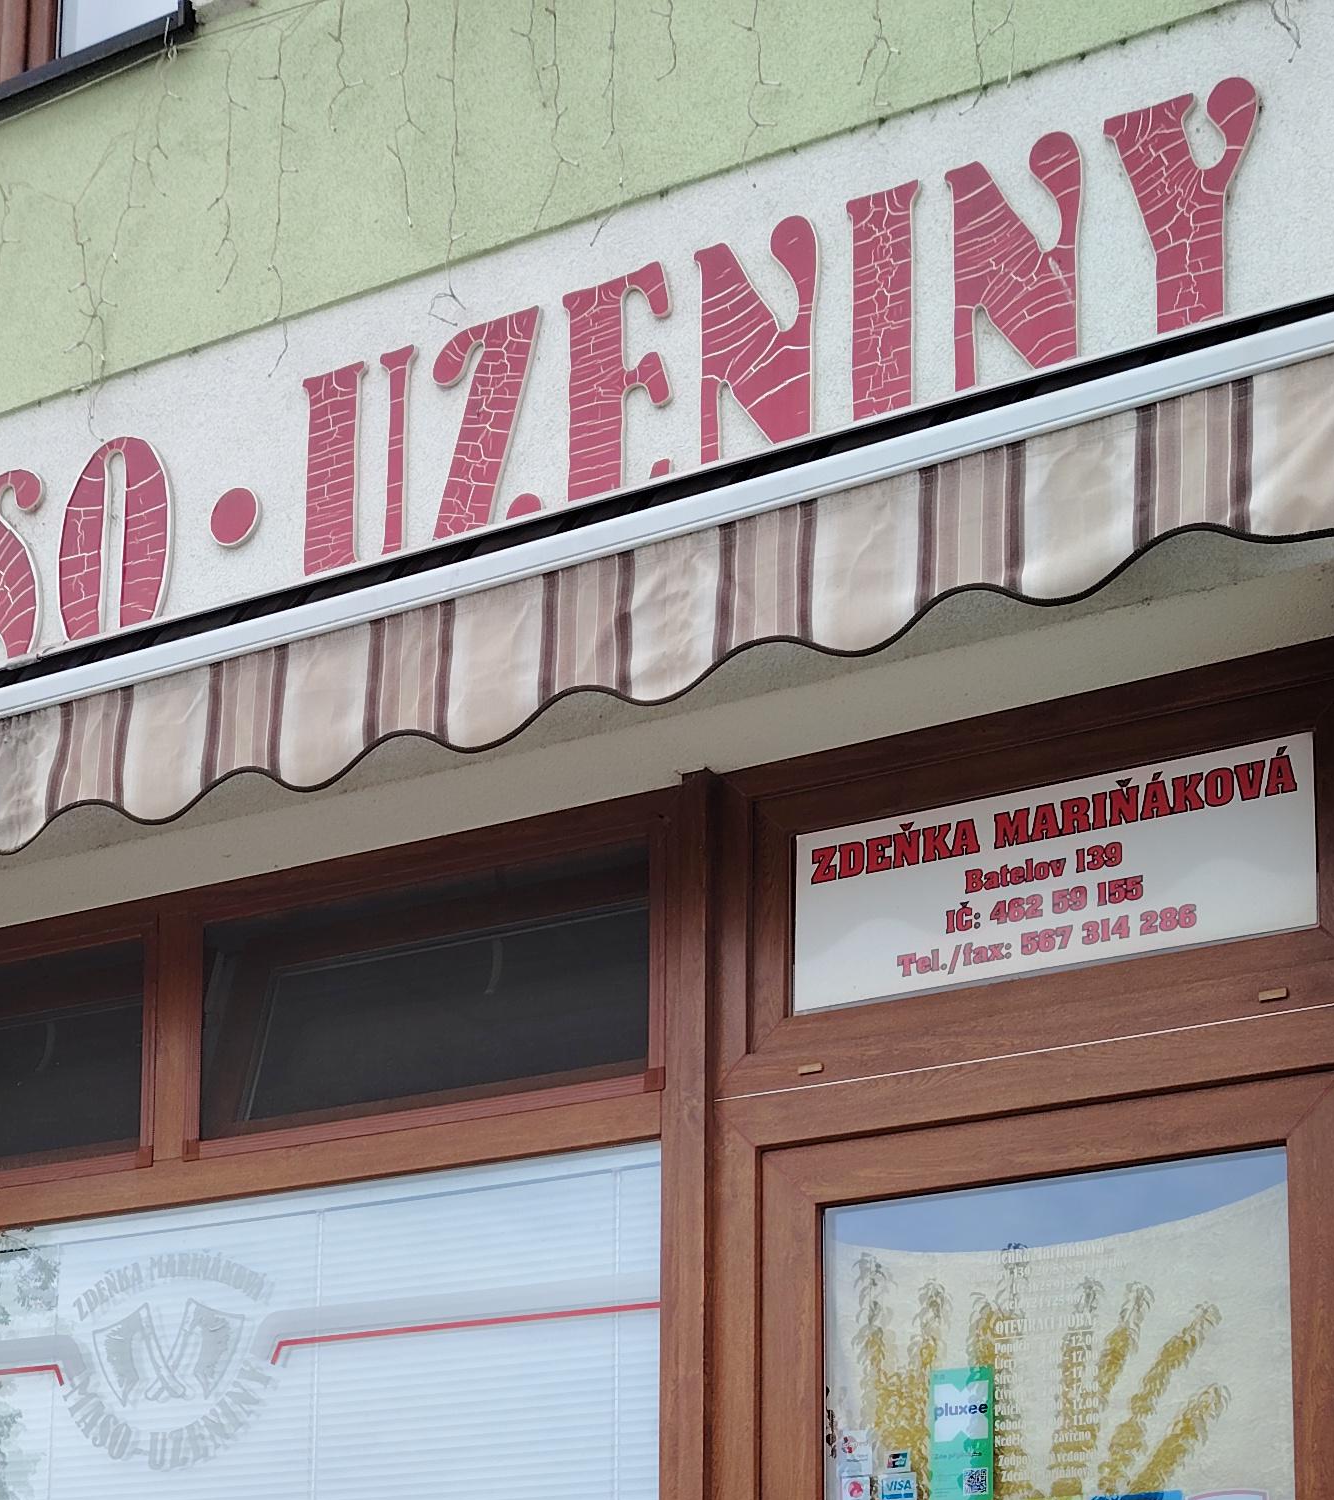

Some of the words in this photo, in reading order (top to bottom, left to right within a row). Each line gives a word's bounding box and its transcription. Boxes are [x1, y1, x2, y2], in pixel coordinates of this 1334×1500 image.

[302, 76, 1260, 577] UZENINY
[810, 818, 981, 885] ZDEŇKA
[993, 746, 1299, 849] MARIŇÁKOVÁ
[964, 857, 1067, 894] Batelov
[1075, 841, 1124, 873] 139
[945, 901, 982, 935] IČ:
[989, 893, 1044, 926] 462
[1051, 887, 1087, 917] 59
[1096, 874, 1144, 907] 155
[896, 938, 1013, 978] Tel./fax:
[1020, 925, 1070, 957] 567
[1081, 912, 1131, 946] 314
[1140, 902, 1198, 937] 286
[933, 1402, 988, 1421] pluxee
[886, 1479, 912, 1491] VISA
